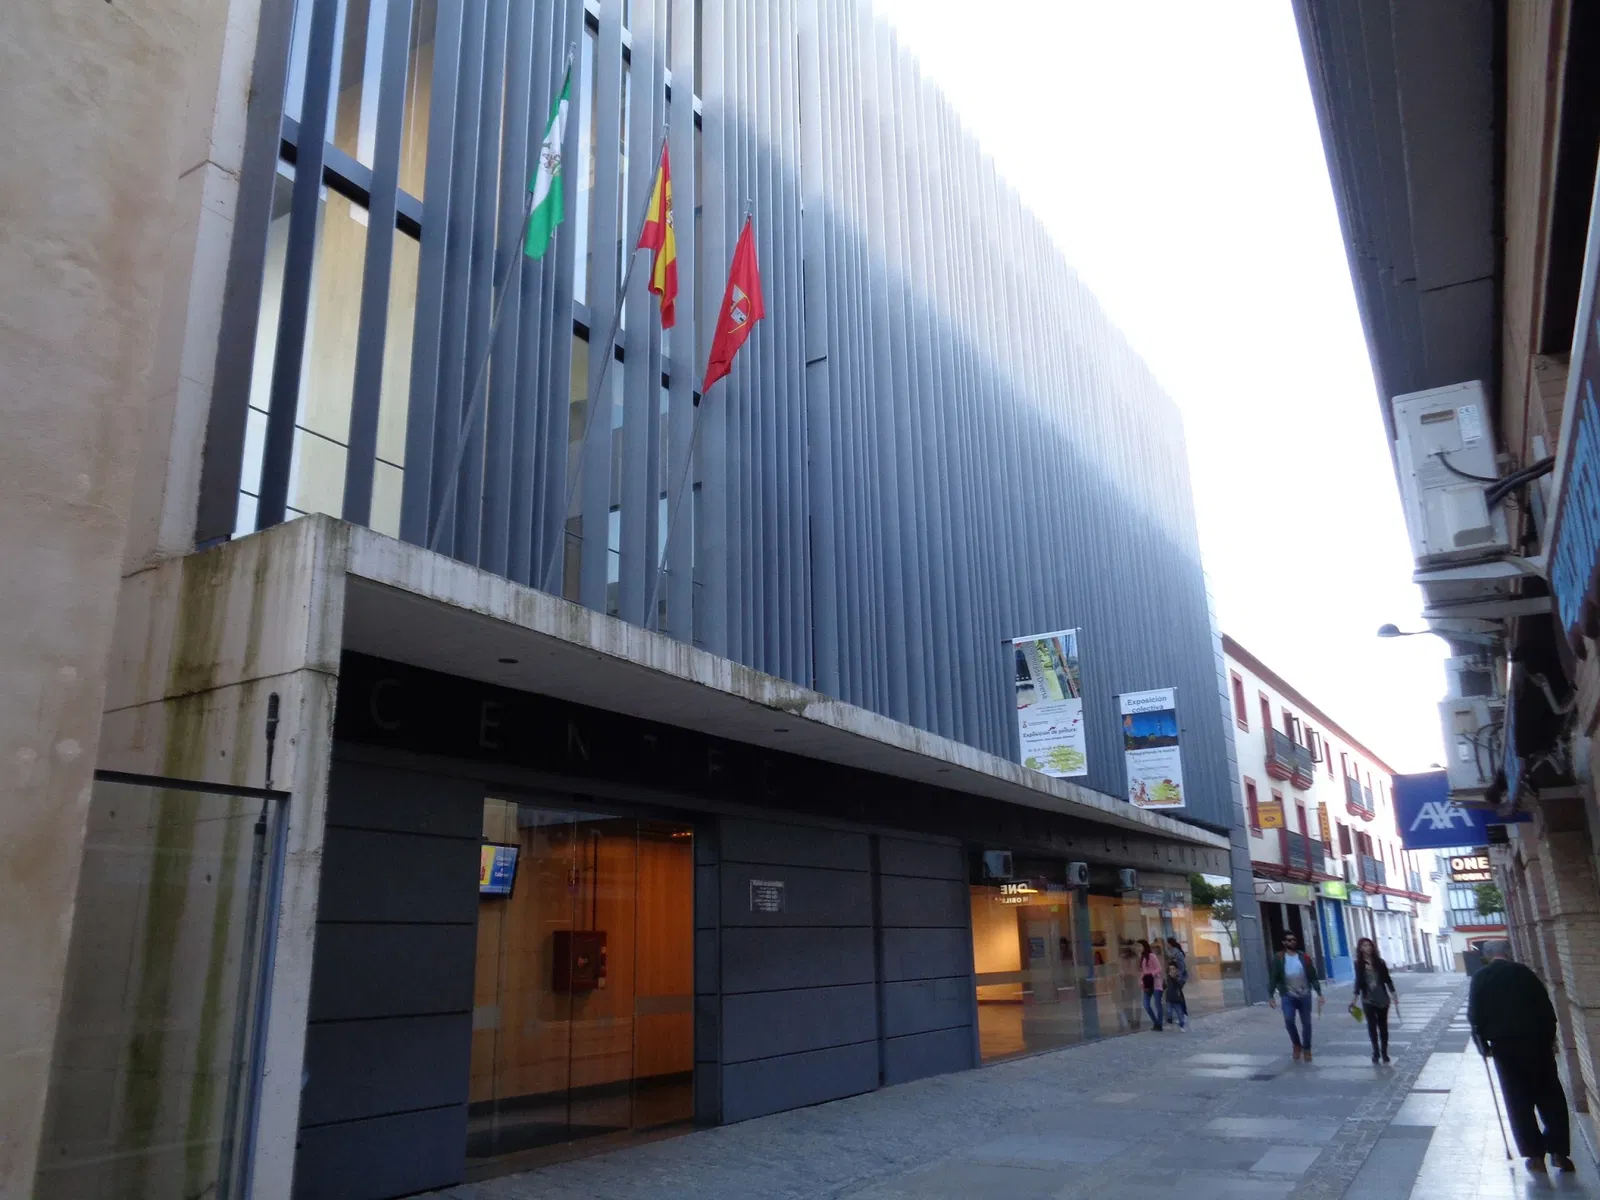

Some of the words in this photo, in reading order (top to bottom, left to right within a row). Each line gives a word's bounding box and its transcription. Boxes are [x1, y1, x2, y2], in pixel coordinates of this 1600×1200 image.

[1127, 696, 1167, 706] Exposición
[1131, 705, 1164, 714] colectiva
[1408, 801, 1476, 831] AXA
[1451, 856, 1490, 871] ONE
